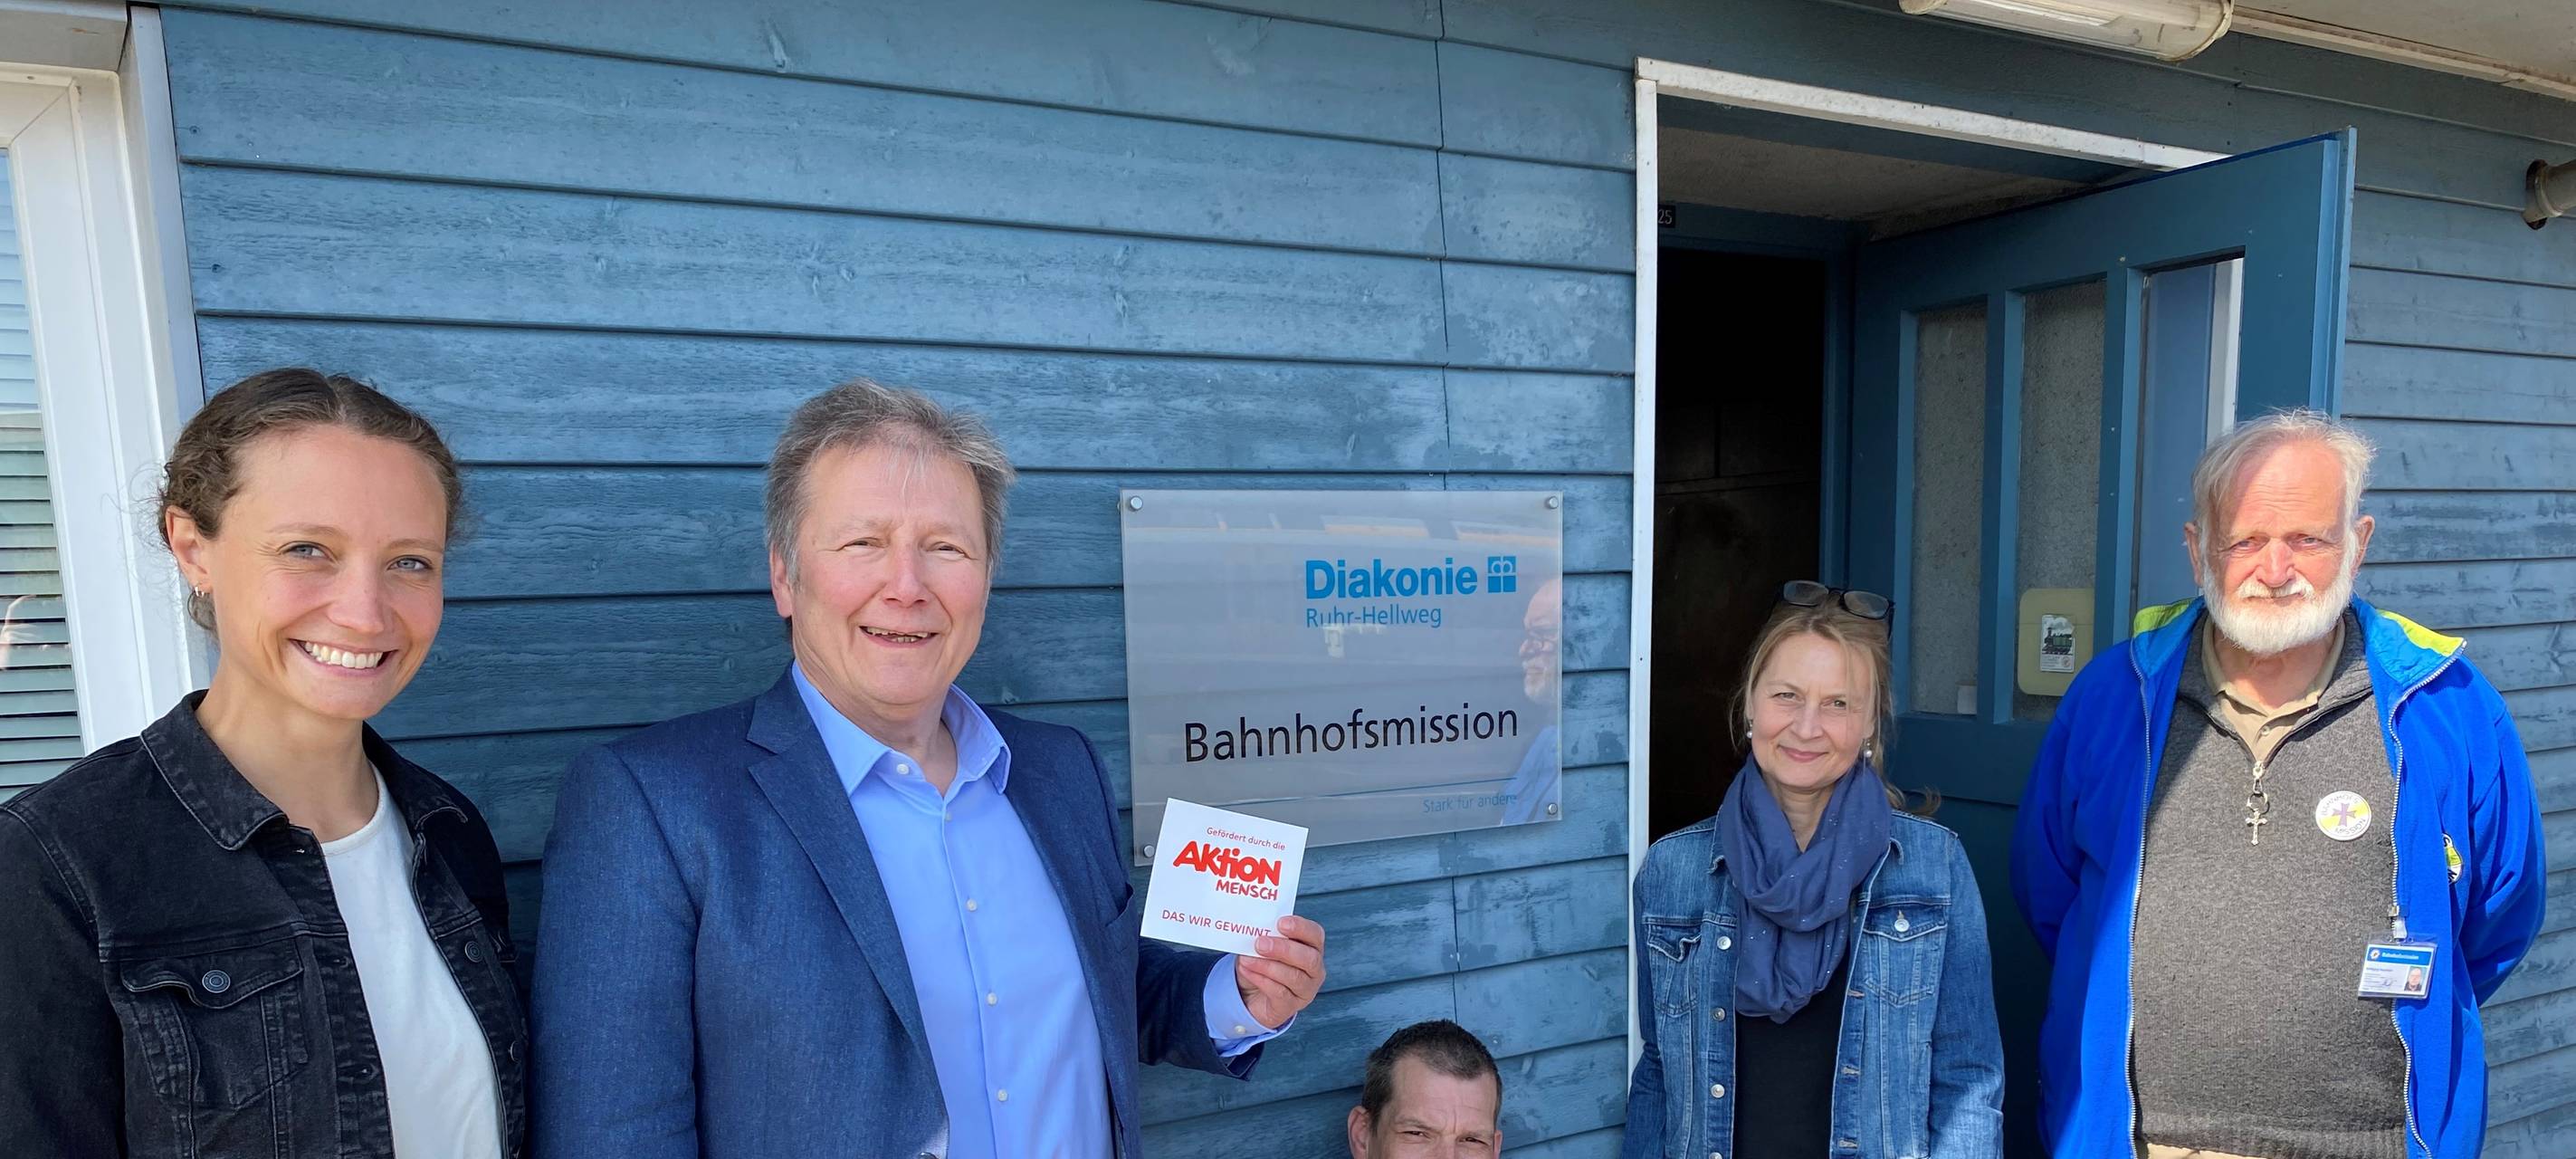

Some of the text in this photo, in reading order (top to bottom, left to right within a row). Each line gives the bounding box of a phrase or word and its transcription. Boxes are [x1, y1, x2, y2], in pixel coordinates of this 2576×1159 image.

[1305, 557, 1478, 599] Diakonie
[1306, 603, 1442, 628] Ruhr-Hellweg
[1185, 702, 1518, 762] Bahnhofsmission
[1423, 792, 1517, 813] Stark für andere
[1207, 827, 1286, 851] Gefördert durch die
[1216, 879, 1278, 901] MENSCH
[1162, 909, 1272, 937] DAS WIR GEWINNT
